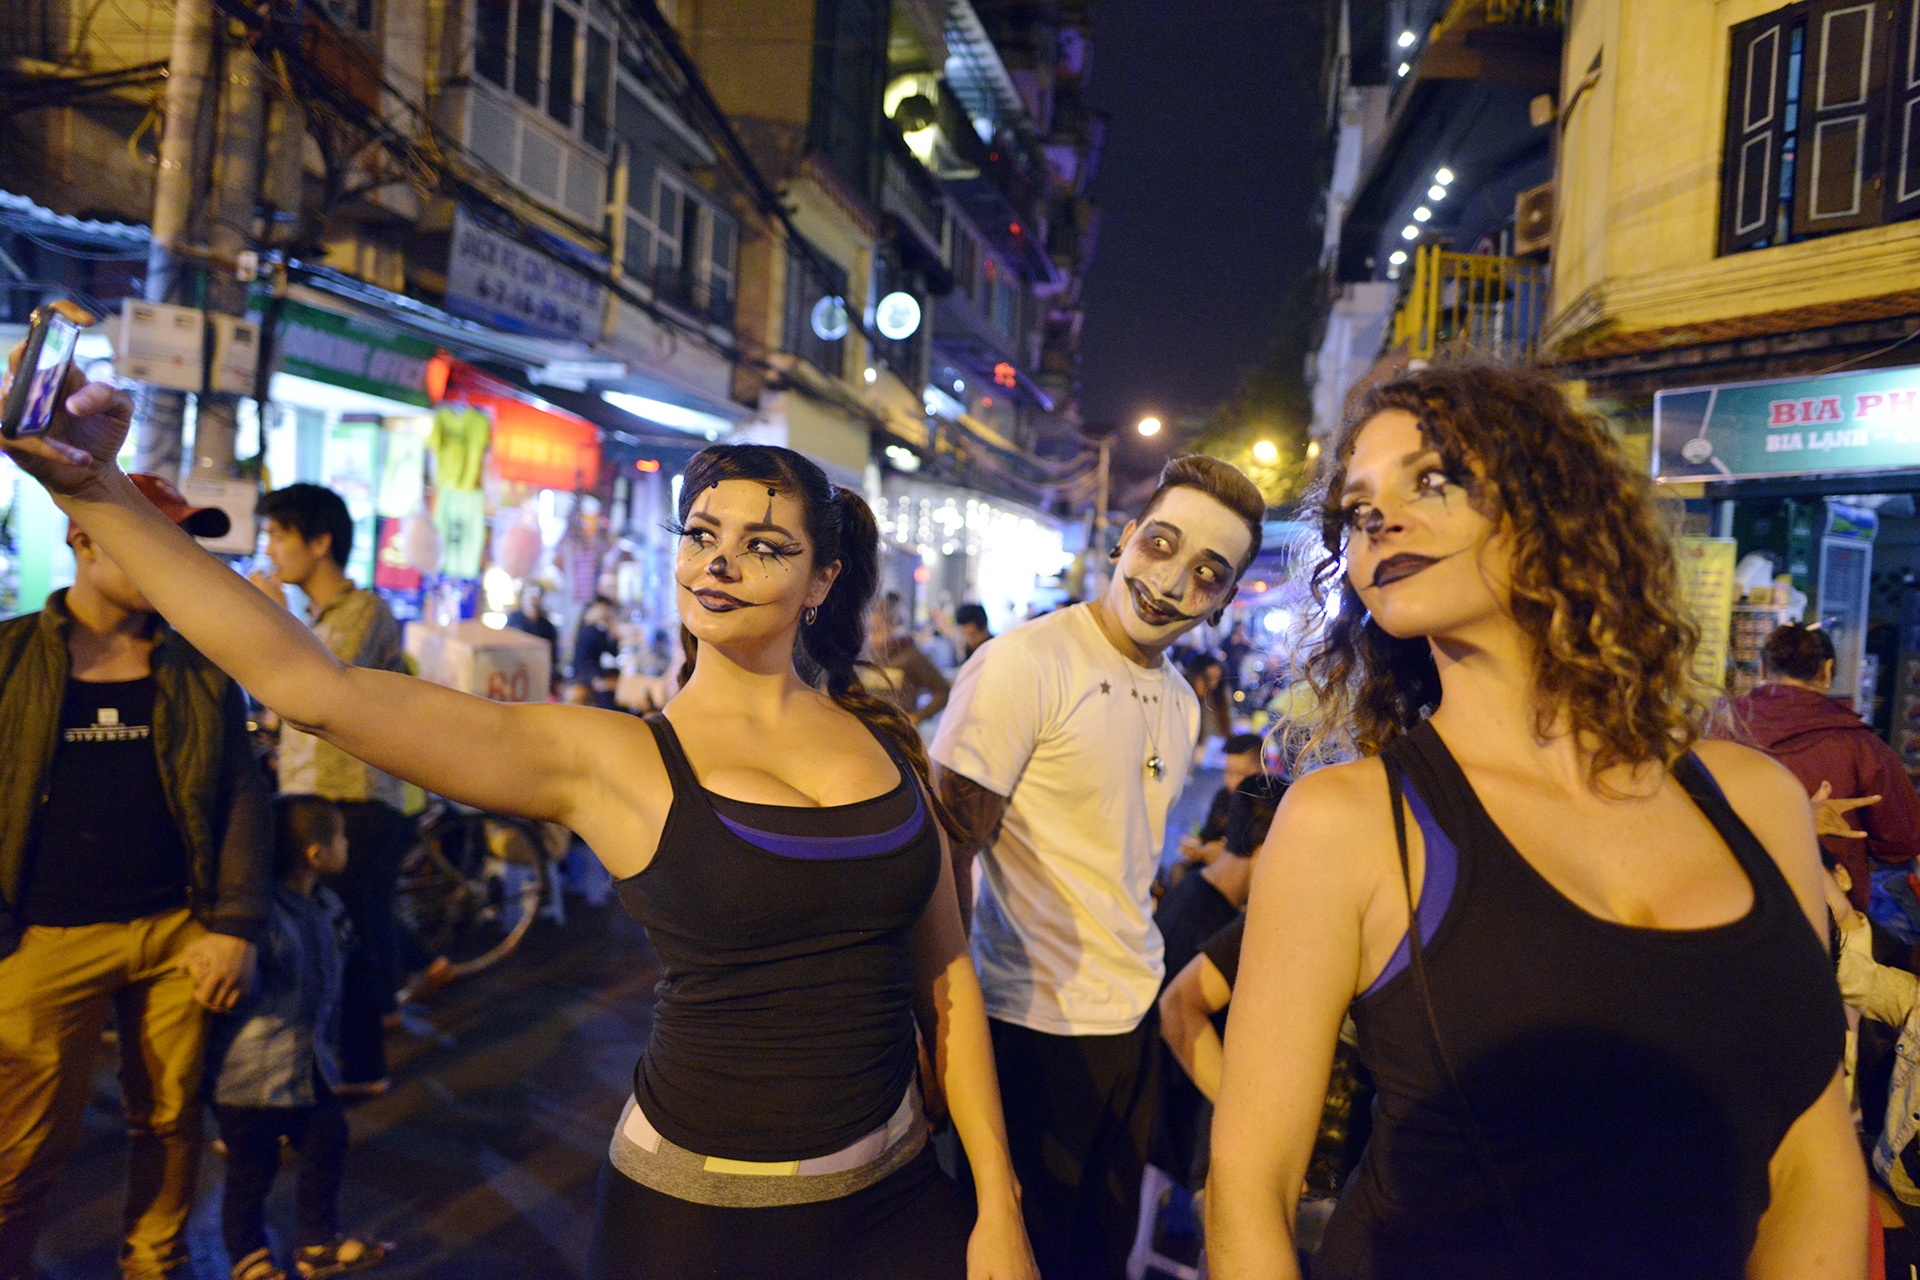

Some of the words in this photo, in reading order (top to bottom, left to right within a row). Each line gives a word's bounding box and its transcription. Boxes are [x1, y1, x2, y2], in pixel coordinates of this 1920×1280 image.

[1770, 396, 1843, 426] BIA
[1766, 433, 1803, 452] BIA
[1807, 427, 1869, 452] LẠNH
